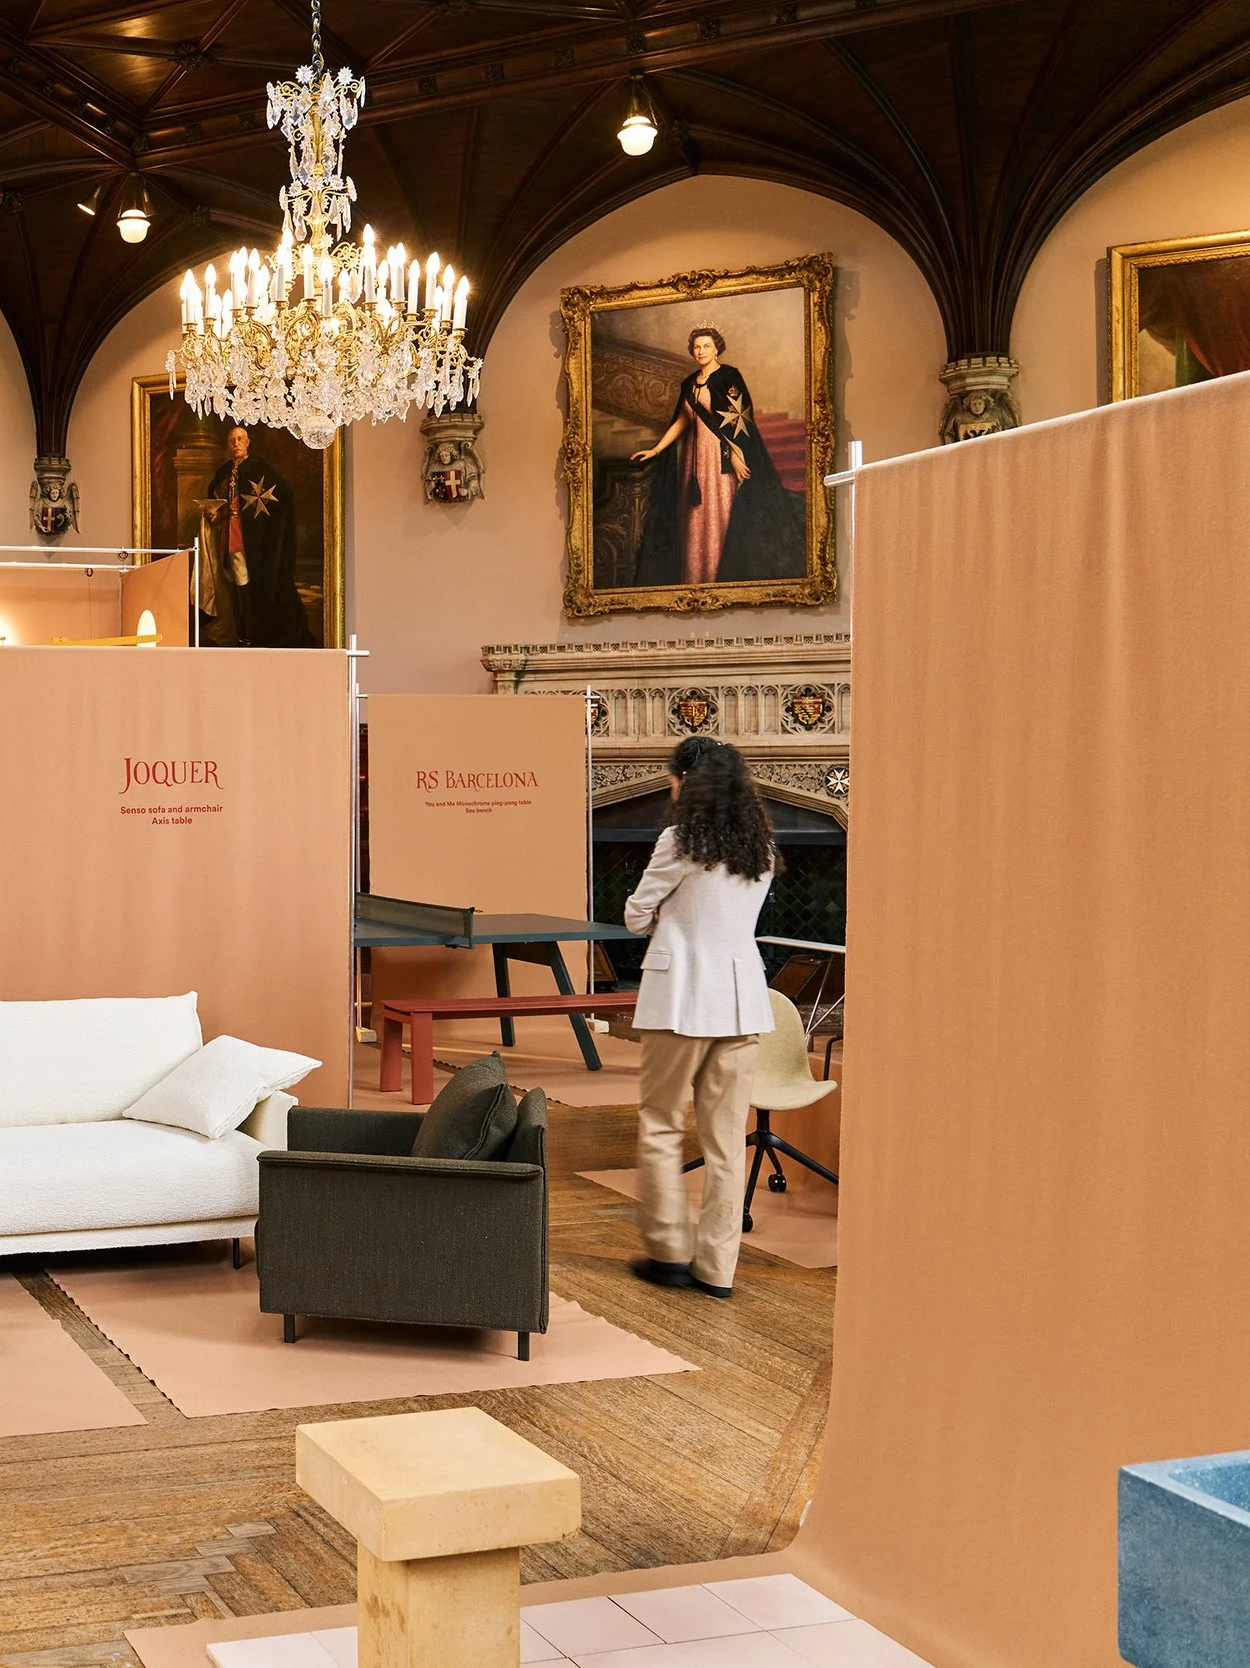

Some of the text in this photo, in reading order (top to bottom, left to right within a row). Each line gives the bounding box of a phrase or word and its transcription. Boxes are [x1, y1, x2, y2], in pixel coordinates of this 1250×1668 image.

[118, 757, 224, 795] JOQUER
[416, 770, 539, 794] RS BARCELONA
[491, 799, 518, 808] ping-pong
[120, 804, 223, 815] Senso sofa and armchair
[151, 816, 193, 825] Axis table
